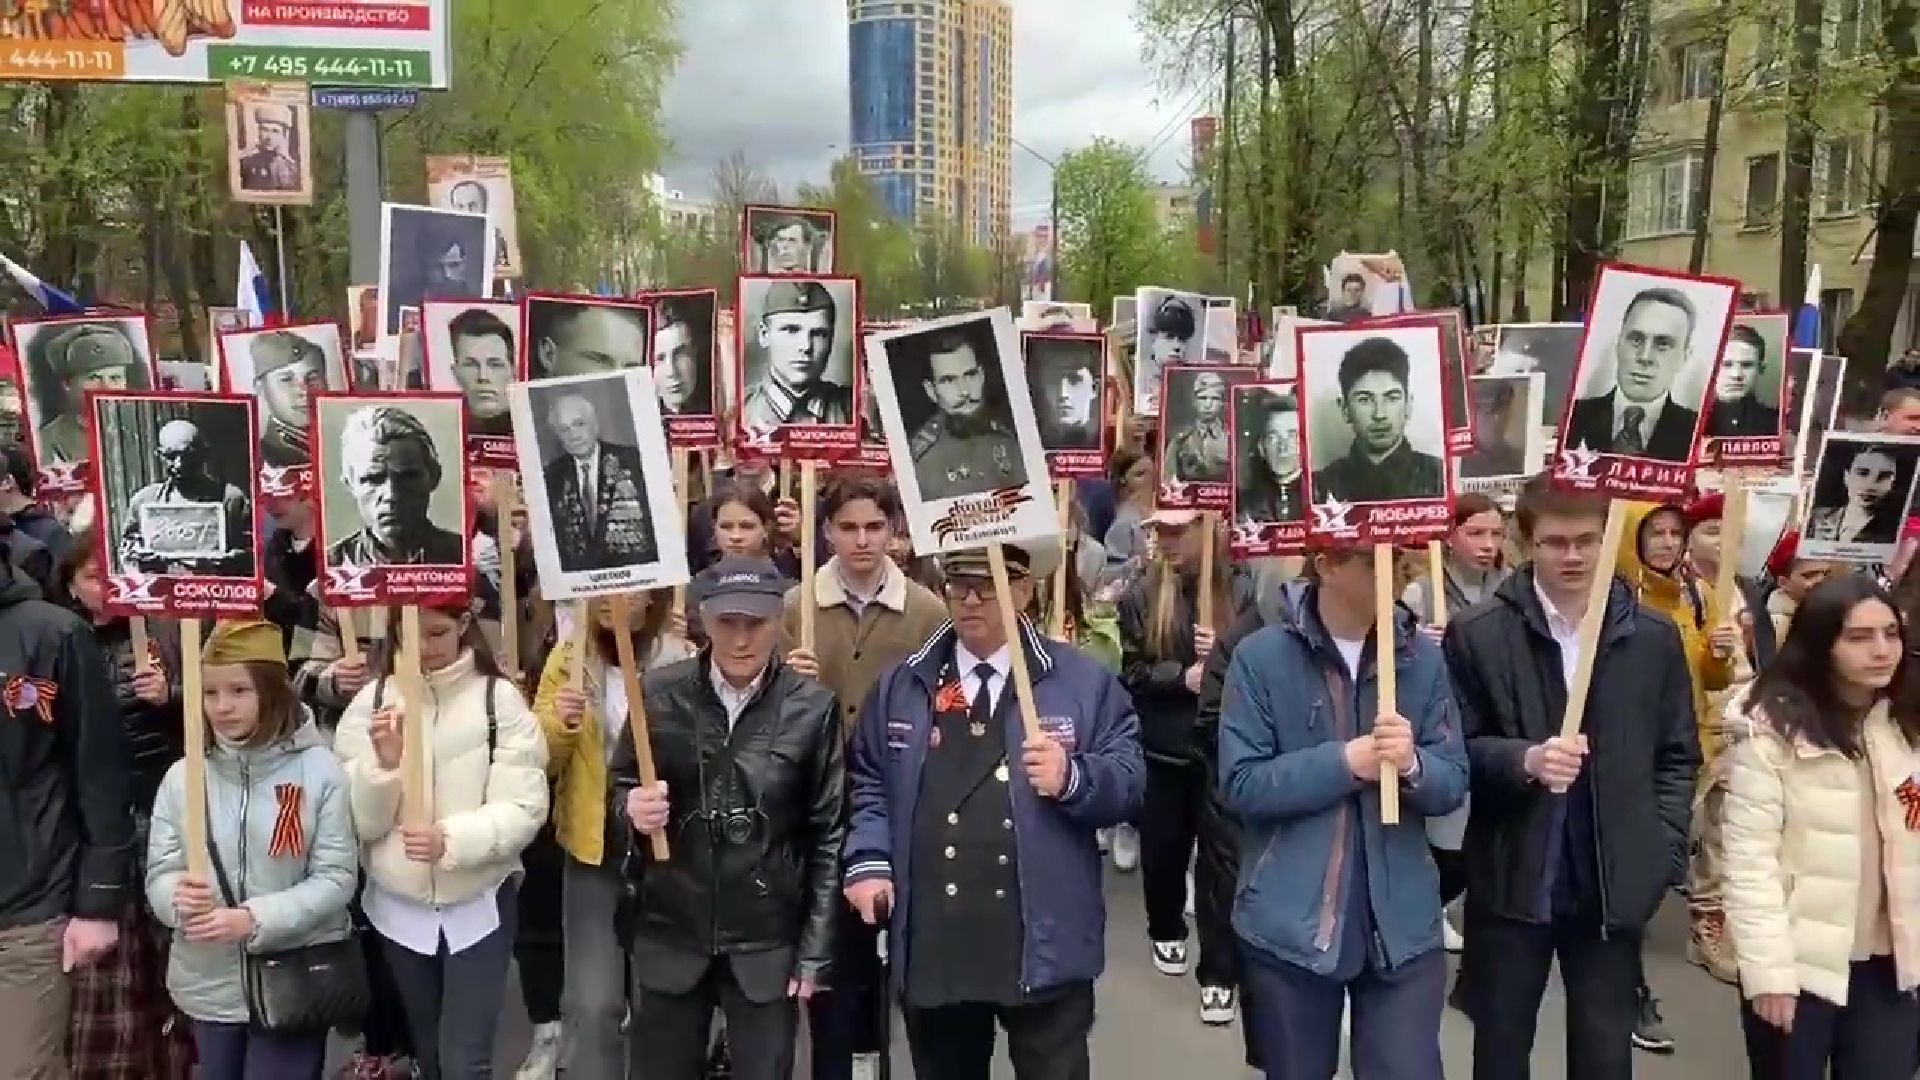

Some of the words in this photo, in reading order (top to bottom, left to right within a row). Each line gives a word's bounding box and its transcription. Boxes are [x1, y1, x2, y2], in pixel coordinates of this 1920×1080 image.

[249, 5, 271, 17] НА
[275, 5, 409, 23] ПРОИЗВОДСТВО
[9, 49, 113, 69] 444-11-11
[229, 56, 256, 73] +7
[263, 54, 307, 75] 495
[313, 57, 412, 78] 444-11-11
[1607, 463, 1687, 484] ЛАРИН
[1368, 505, 1450, 523] ЛЮБАРЕВ
[386, 571, 466, 583] ХАРИТОНОВ
[173, 582, 257, 599] СОКОЛОВ
